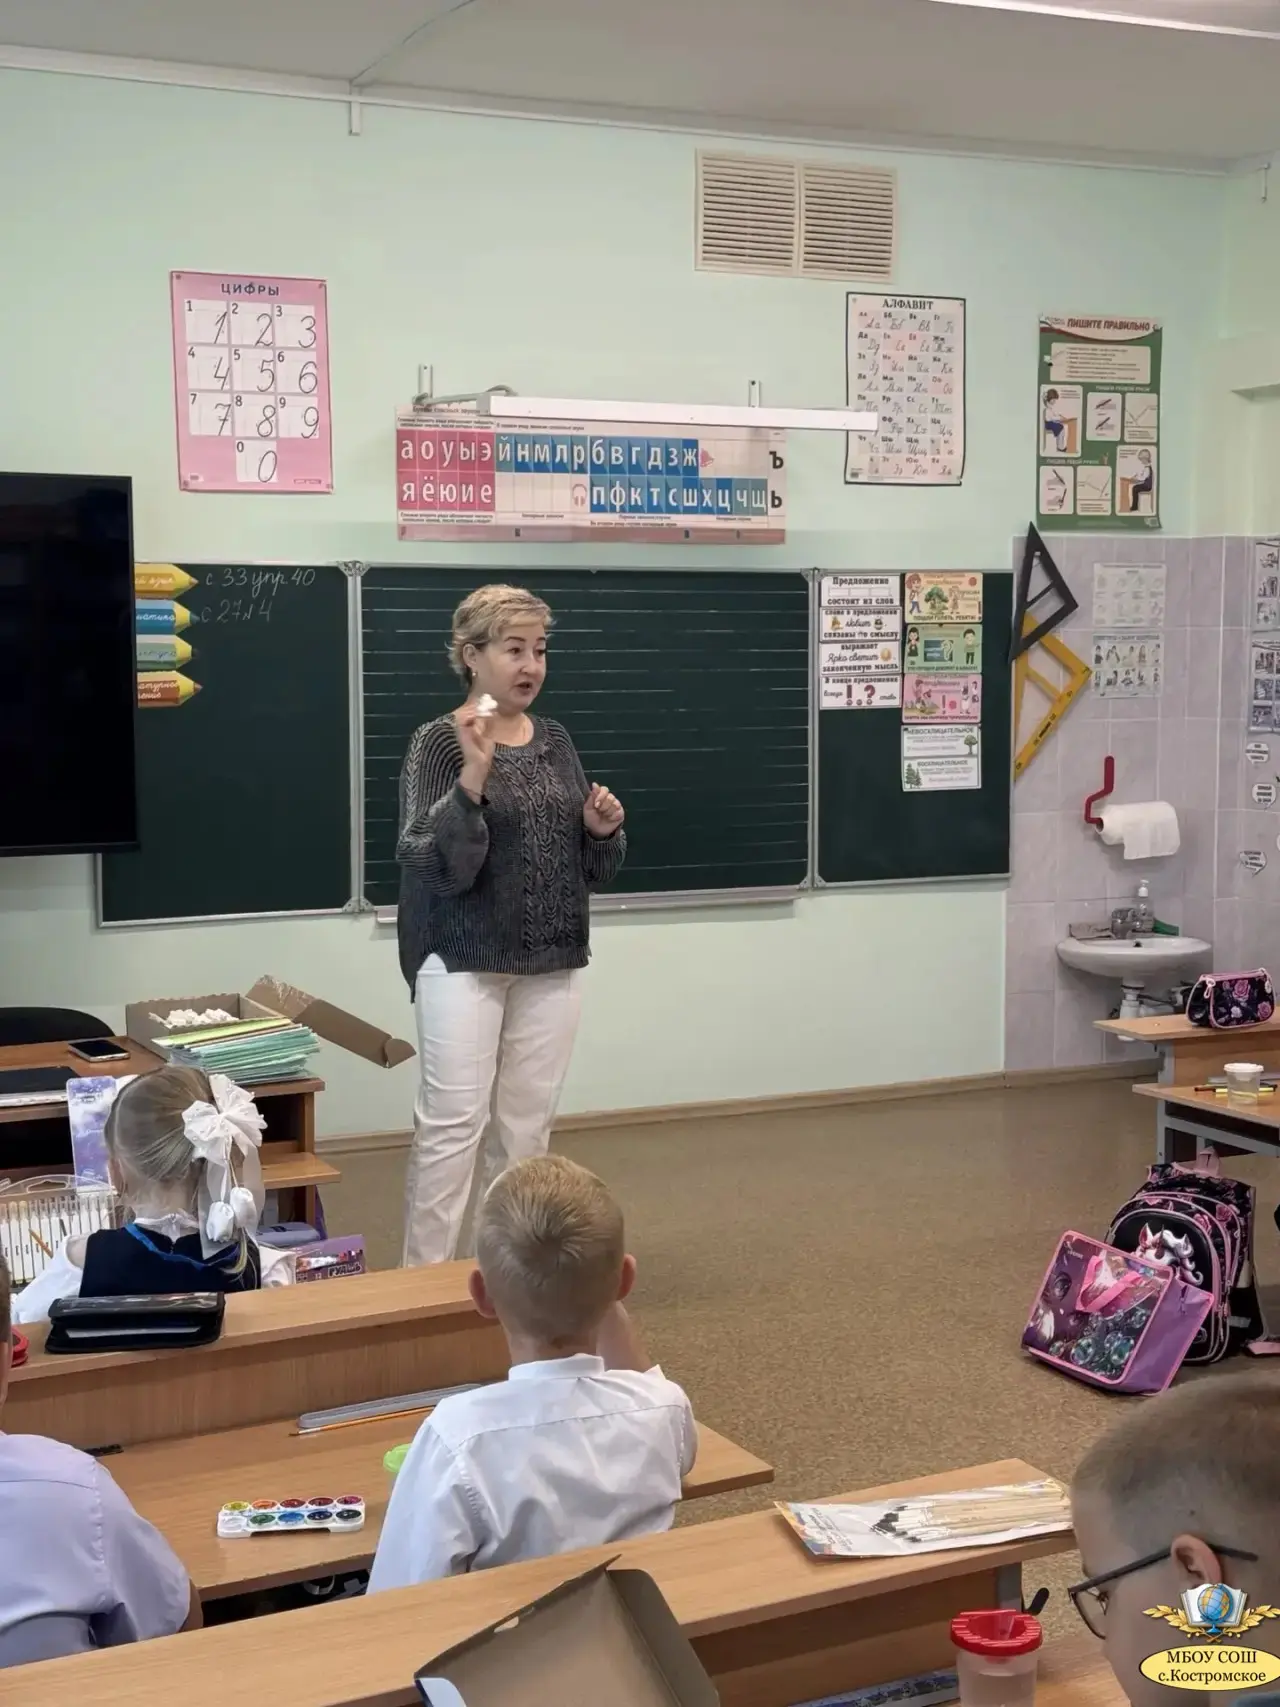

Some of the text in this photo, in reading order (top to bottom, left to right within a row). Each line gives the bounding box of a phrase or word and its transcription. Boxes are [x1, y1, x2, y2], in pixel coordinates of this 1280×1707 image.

[221, 282, 279, 296] ЦИФРЫ
[187, 301, 193, 312] 1
[232, 304, 239, 315] 2
[276, 306, 283, 317] 3
[882, 299, 934, 310] АЛФАВИТ
[215, 311, 228, 344] 1
[255, 313, 273, 347] 2
[299, 315, 317, 348] 3
[1067, 318, 1101, 329] ПИШИТЕ
[1103, 320, 1150, 331] ПРАВИЛЬНО
[188, 347, 196, 358] 4
[233, 350, 241, 360] 5
[277, 352, 285, 362] 6
[214, 356, 230, 390] 4
[257, 360, 275, 392] 5
[299, 361, 318, 394] 6
[190, 394, 197, 405] 7
[236, 395, 242, 406] 8
[279, 397, 286, 408] 9
[215, 403, 232, 436] 7
[257, 405, 276, 437] 8
[301, 407, 319, 439] 9
[236, 441, 244, 453] 0
[401, 440, 492, 467] а о у ы э
[500, 436, 585, 470] й н м л р
[592, 439, 697, 471] б в г д з ж
[258, 451, 278, 483] 0
[402, 476, 493, 504] я ё ю и е
[592, 480, 767, 513] п ф к т с ш х ц ч щ
[222, 568, 248, 587] 33
[291, 568, 316, 586] 40
[216, 599, 242, 623] 27
[259, 598, 272, 622] 4
